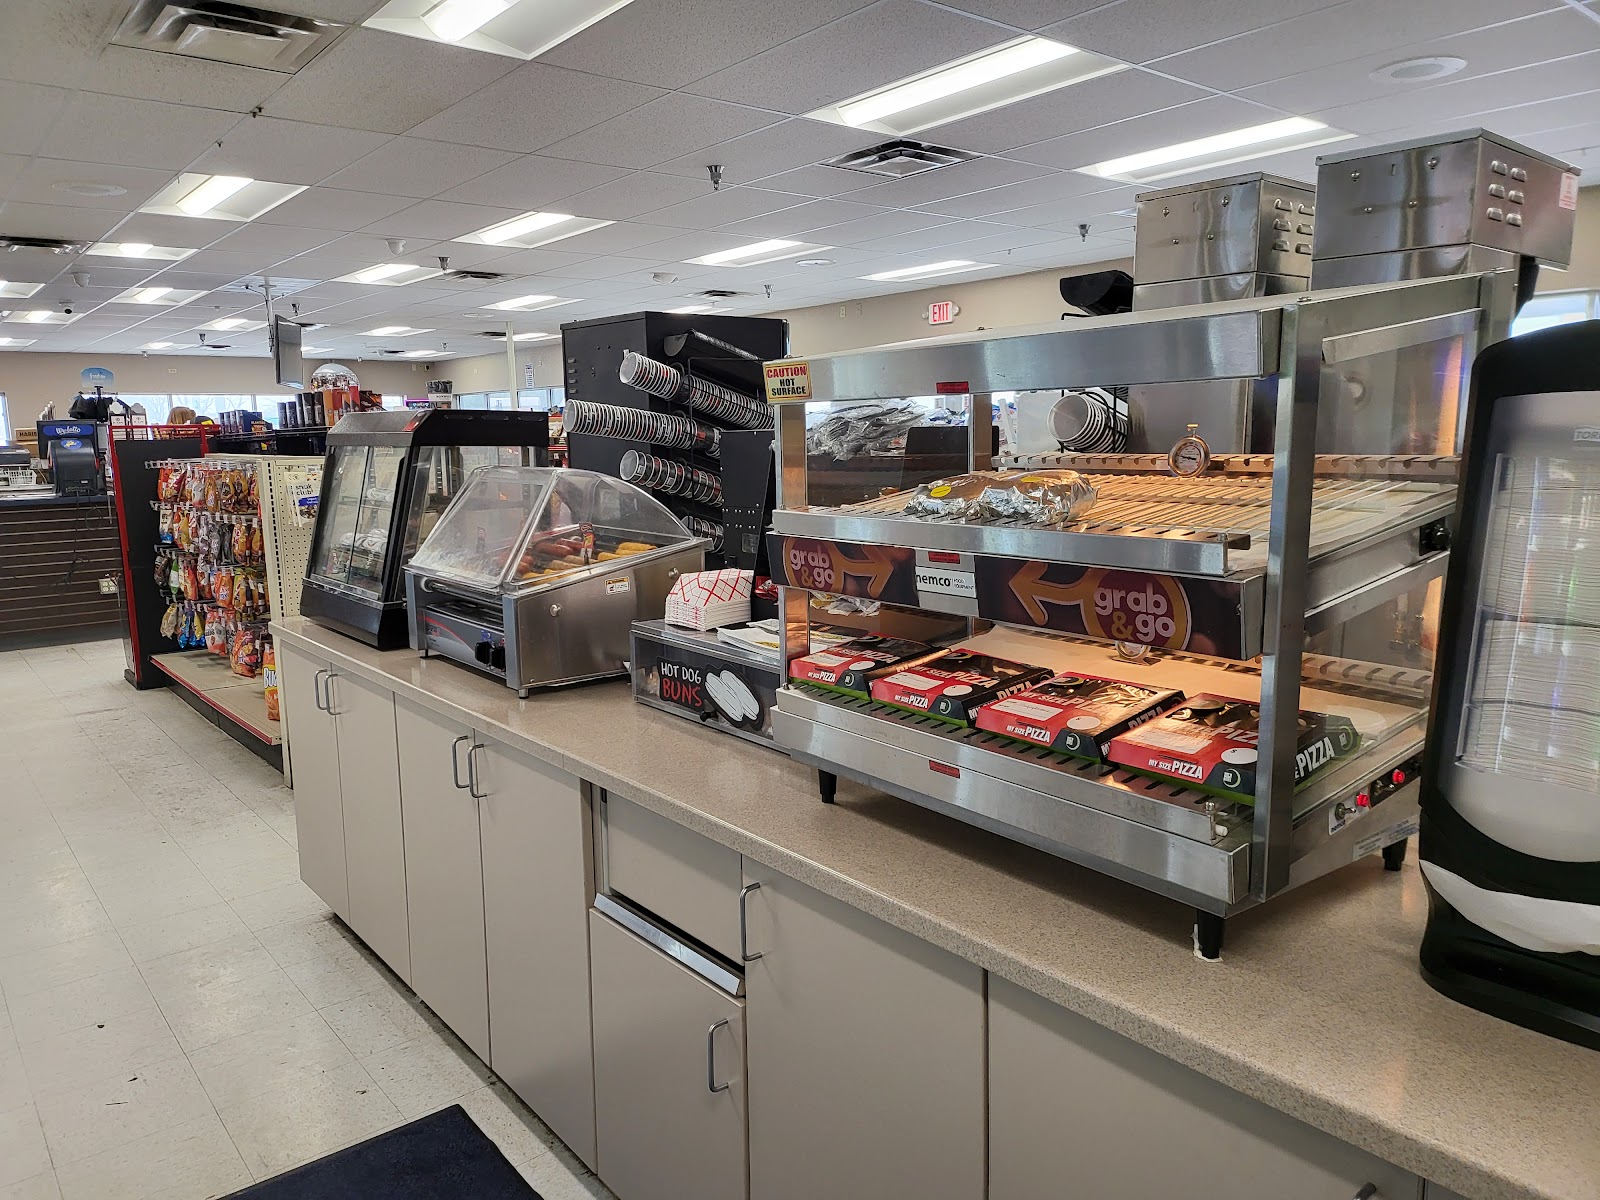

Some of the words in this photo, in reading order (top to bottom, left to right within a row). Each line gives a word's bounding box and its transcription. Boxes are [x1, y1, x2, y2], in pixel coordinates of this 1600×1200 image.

[932, 302, 950, 323] EXIT
[767, 365, 807, 379] CAUTION
[779, 378, 796, 387] HOT
[771, 386, 807, 396] SURFACE
[789, 545, 830, 571] grab
[801, 566, 815, 588] &
[813, 567, 835, 588] go
[915, 573, 951, 588] nemco
[1093, 582, 1168, 616] grab
[1111, 611, 1134, 641] &
[1135, 614, 1176, 643] go
[660, 661, 680, 677] HOT
[681, 666, 702, 684] DOG
[819, 671, 837, 683] PIZZA
[662, 678, 703, 707] BUNS
[909, 695, 929, 709] PIZZA
[1024, 725, 1051, 743] PIZZA
[1295, 736, 1335, 778] PIZZA
[1148, 758, 1159, 768] MY
[1158, 760, 1172, 771] SIZE
[1171, 760, 1204, 780] PIZZA
